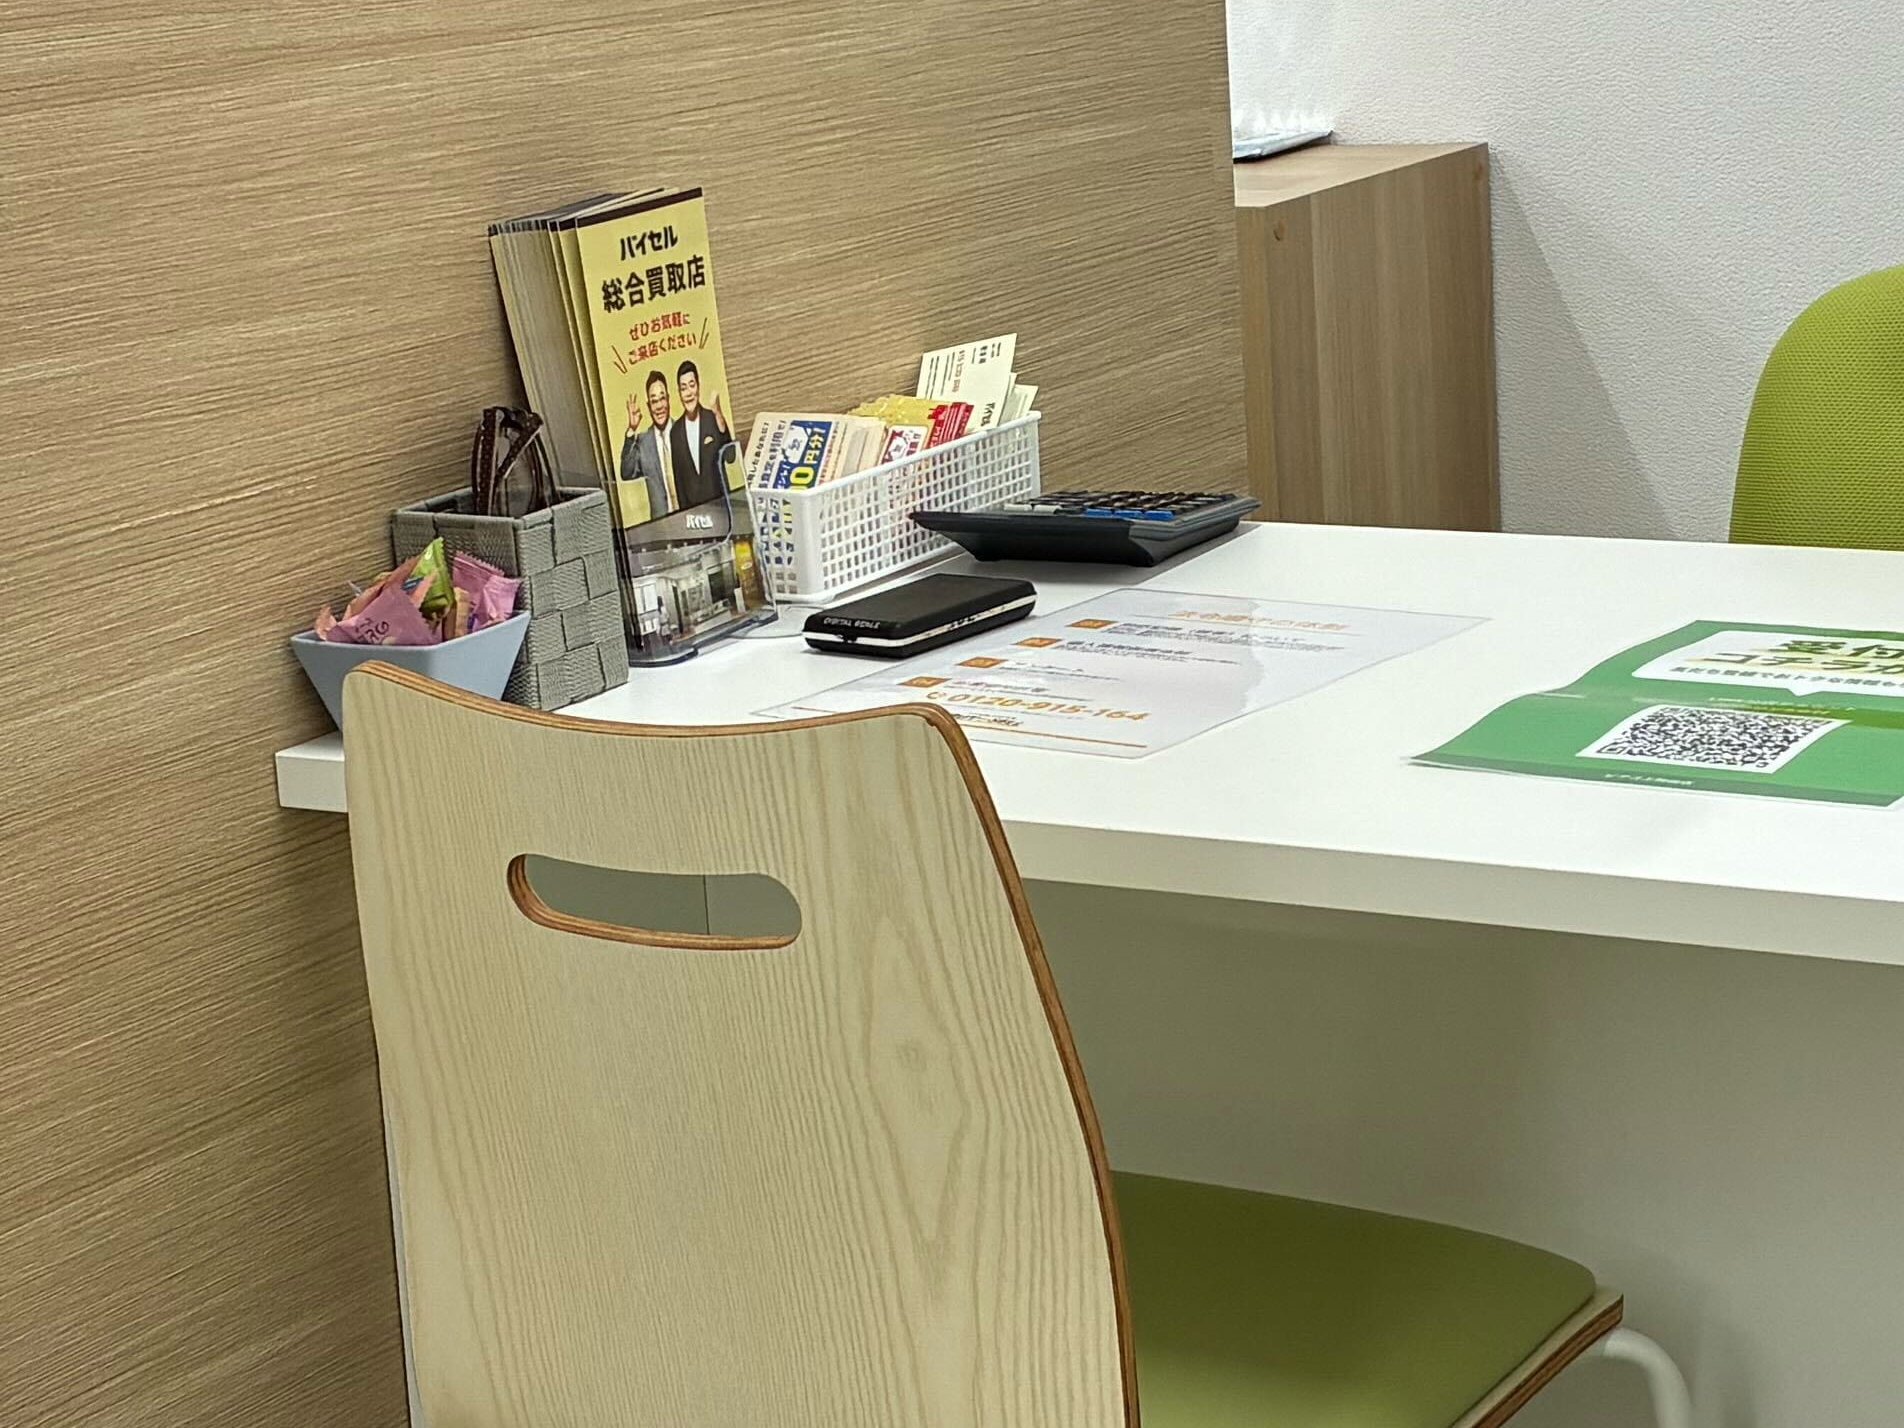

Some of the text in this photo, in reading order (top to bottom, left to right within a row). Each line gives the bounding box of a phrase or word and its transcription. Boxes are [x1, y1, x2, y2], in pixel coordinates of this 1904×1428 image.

[620, 225, 679, 261] バイセル
[601, 254, 706, 313] 総合買取店
[629, 311, 690, 341] ぜひお気軽に
[628, 333, 697, 365] ご来店ください
[947, 691, 1152, 722] 0120-915-164
